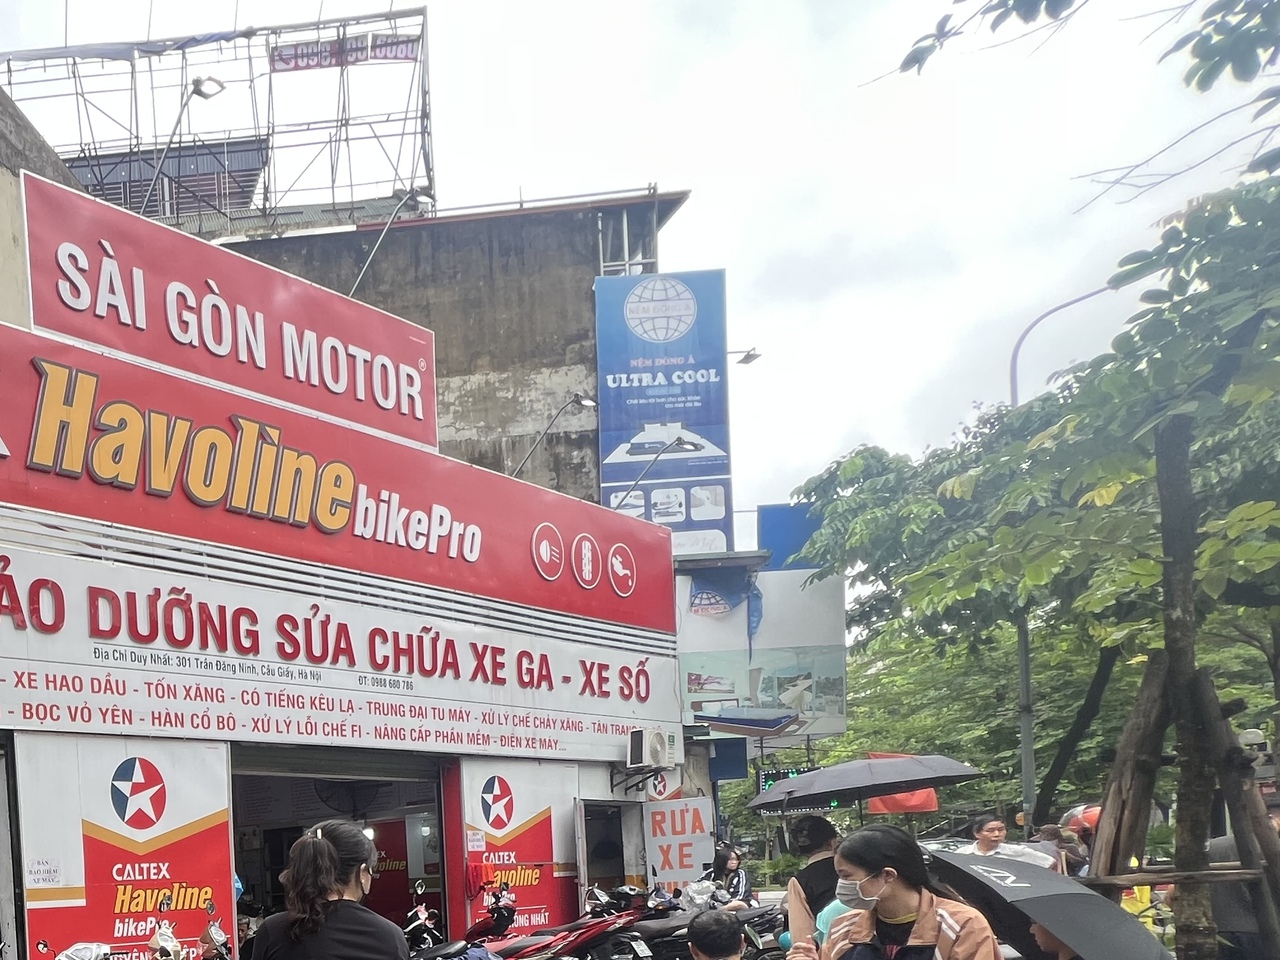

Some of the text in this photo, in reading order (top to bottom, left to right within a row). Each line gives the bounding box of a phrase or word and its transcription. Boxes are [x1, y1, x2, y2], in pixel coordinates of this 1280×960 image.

[56, 239, 424, 420] SÀI GÒN MOTOR
[606, 368, 720, 389] ULTRA COOL
[354, 483, 482, 563] bikePro
[87, 584, 261, 655] DƯỠNG
[276, 603, 356, 667] SỬA
[368, 625, 461, 680] CHỮA
[468, 642, 507, 686] XE
[516, 649, 555, 692] GA
[579, 659, 612, 699] XE
[618, 656, 651, 704] SỐ
[93, 647, 111, 661] Địa
[130, 651, 148, 666] Duy
[150, 653, 174, 668] Nhất:
[175, 655, 192, 668] 301
[215, 658, 237, 675] Đăng
[238, 661, 259, 676] Ninh,
[298, 667, 308, 680] Hà
[309, 668, 322, 681] Nội
[358, 675, 414, 691] ĐT: 0988 680 786
[13, 670, 38, 690] XE
[44, 674, 84, 693] HAO
[91, 672, 126, 697] DẦU
[144, 677, 177, 700] TỐN
[183, 683, 225, 704] XĂNG
[240, 688, 260, 706] CÓ
[264, 688, 305, 710] TIẾNG
[309, 691, 335, 713] KÊU
[339, 698, 354, 717] LẠ
[367, 701, 406, 718] TRUNG
[409, 705, 428, 723] ĐẠI
[431, 707, 445, 721] TU
[448, 707, 471, 723] MÁY
[481, 708, 496, 725] XỬ
[498, 709, 510, 726] LÝ
[512, 711, 532, 728] CHẾ
[533, 712, 558, 731] CHẢY
[560, 717, 583, 733] XĂNG
[22, 703, 60, 725] BỌC
[66, 701, 92, 724] VỎ
[98, 705, 133, 726] YÊN
[151, 708, 185, 729] HÀN
[190, 707, 211, 730] CỔ
[216, 711, 236, 731] BÔ
[251, 713, 270, 734] XỬ
[275, 716, 293, 735] LÝ
[296, 715, 318, 736] LỖI
[322, 718, 347, 737] CHẾ
[351, 723, 361, 738] FI
[374, 724, 406, 741] NÂNG
[410, 725, 432, 743] CẤP
[435, 726, 463, 745] PHẦN
[466, 728, 490, 746] MỀM
[500, 733, 521, 751] ĐIỆN
[524, 736, 537, 749] XE
[650, 803, 706, 838] RỬA
[112, 862, 171, 881] CALTEX
[482, 851, 517, 864] CALTEX
[657, 842, 694, 871] XE
